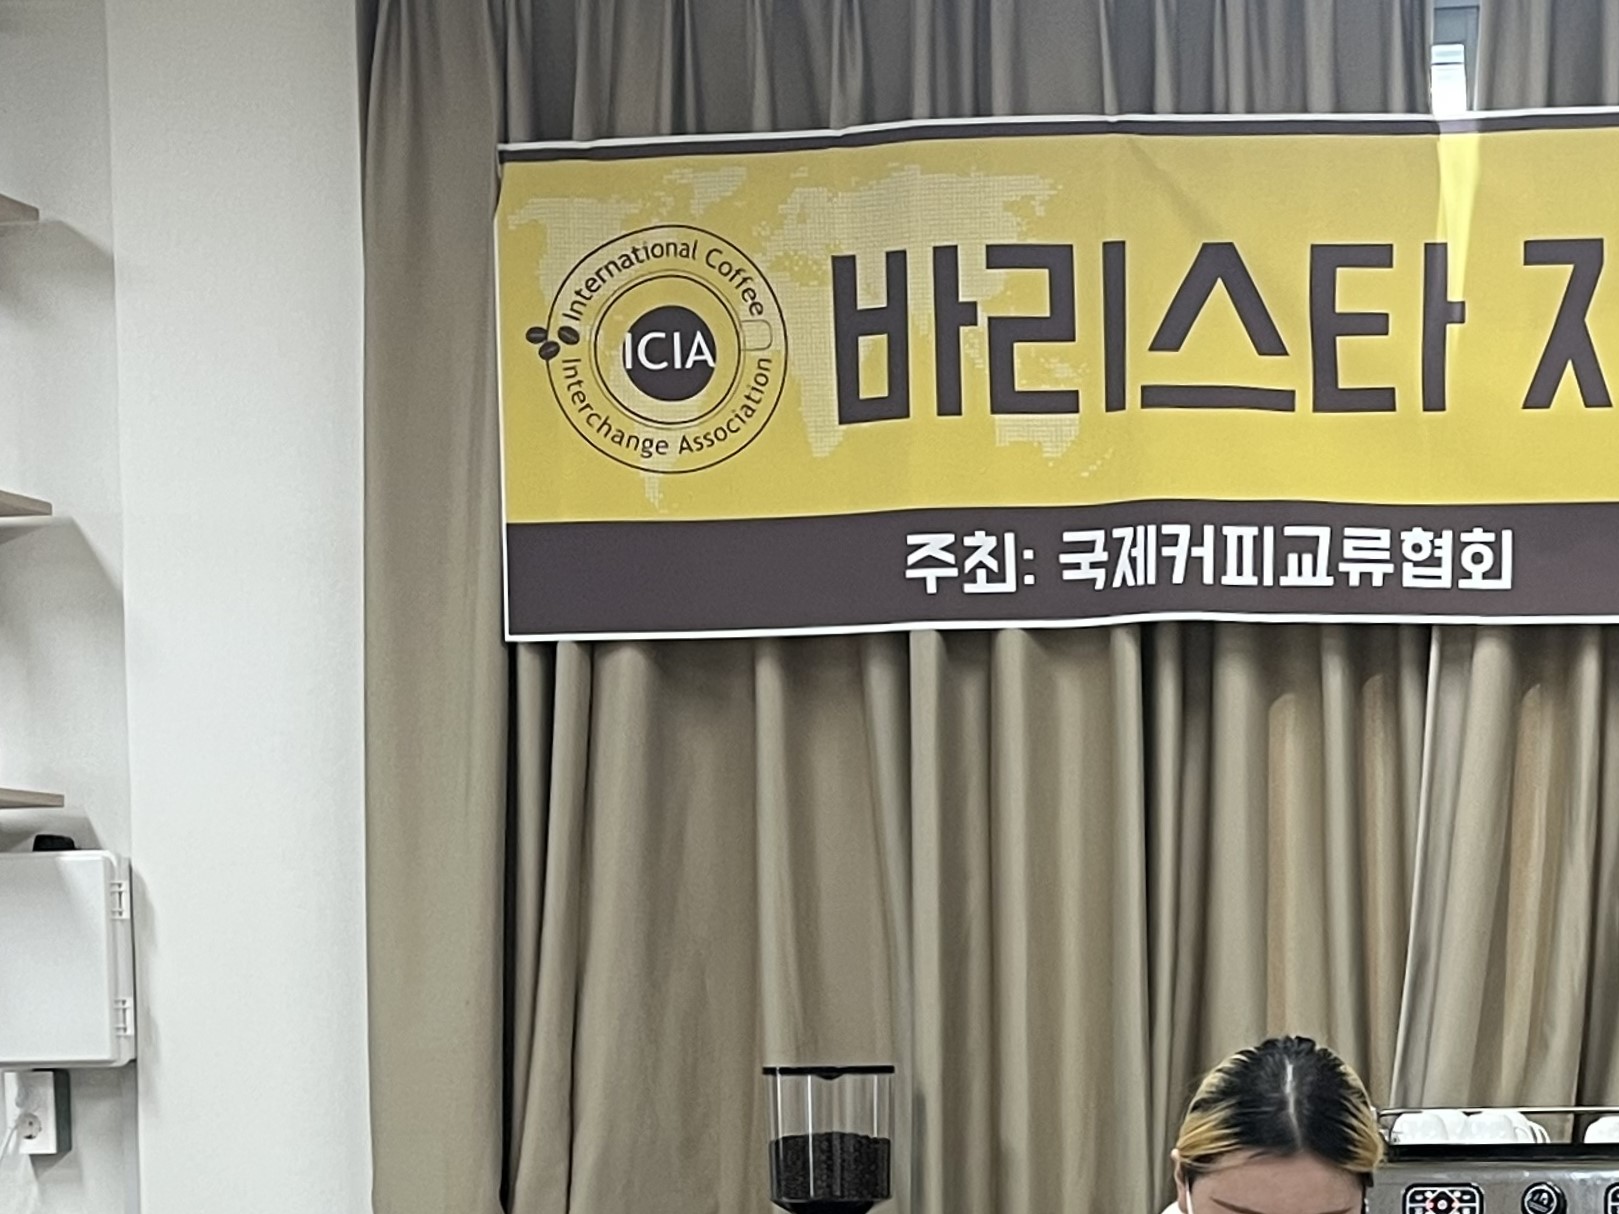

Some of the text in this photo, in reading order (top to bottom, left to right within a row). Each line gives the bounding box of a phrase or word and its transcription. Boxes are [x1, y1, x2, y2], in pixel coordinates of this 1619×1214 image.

[562, 239, 765, 322] International Coffee
[624, 330, 717, 371] ICIA
[831, 240, 1465, 425] 바리스타
[561, 357, 774, 459] Interchange Association
[905, 523, 1514, 594] 주최: 국제커피교류협회
